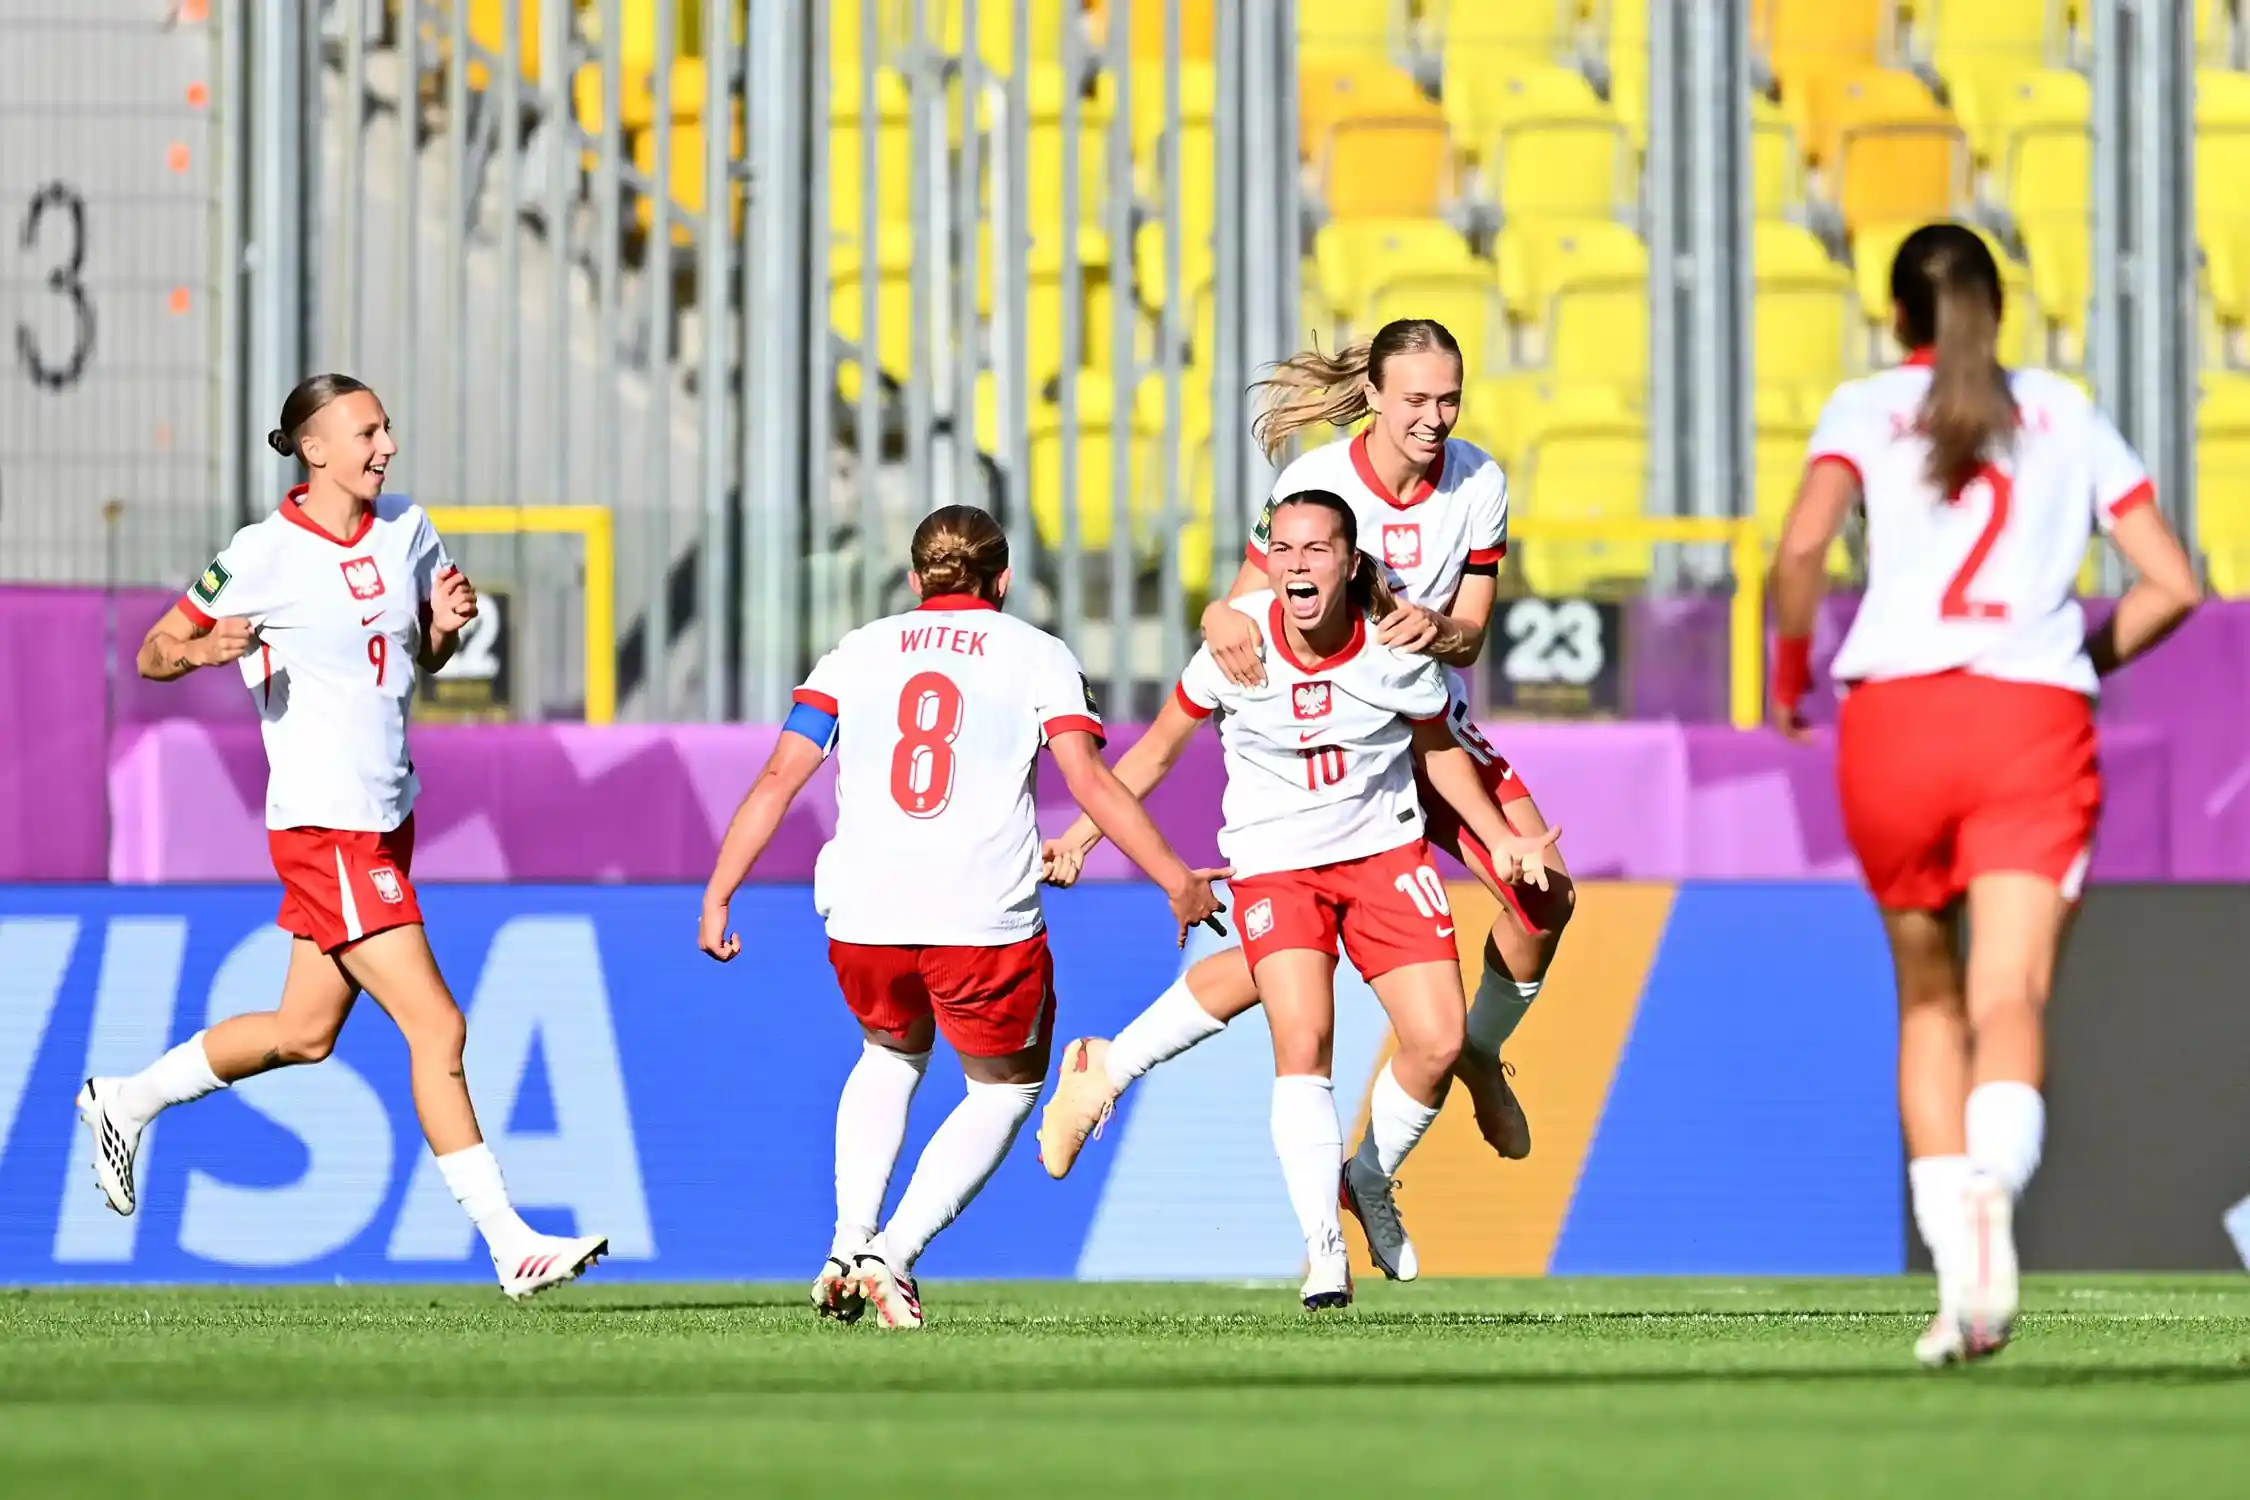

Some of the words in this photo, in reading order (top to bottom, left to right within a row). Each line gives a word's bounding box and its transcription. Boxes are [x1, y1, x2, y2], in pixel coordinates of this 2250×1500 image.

[16, 178, 97, 396] 3
[1940, 456, 2012, 622] 2
[367, 633, 387, 687] 9
[900, 626, 988, 656] WITEK
[1503, 598, 1605, 684] 23
[890, 671, 964, 820] 8
[1297, 744, 1347, 792] 10
[1394, 865, 1450, 918] 10
